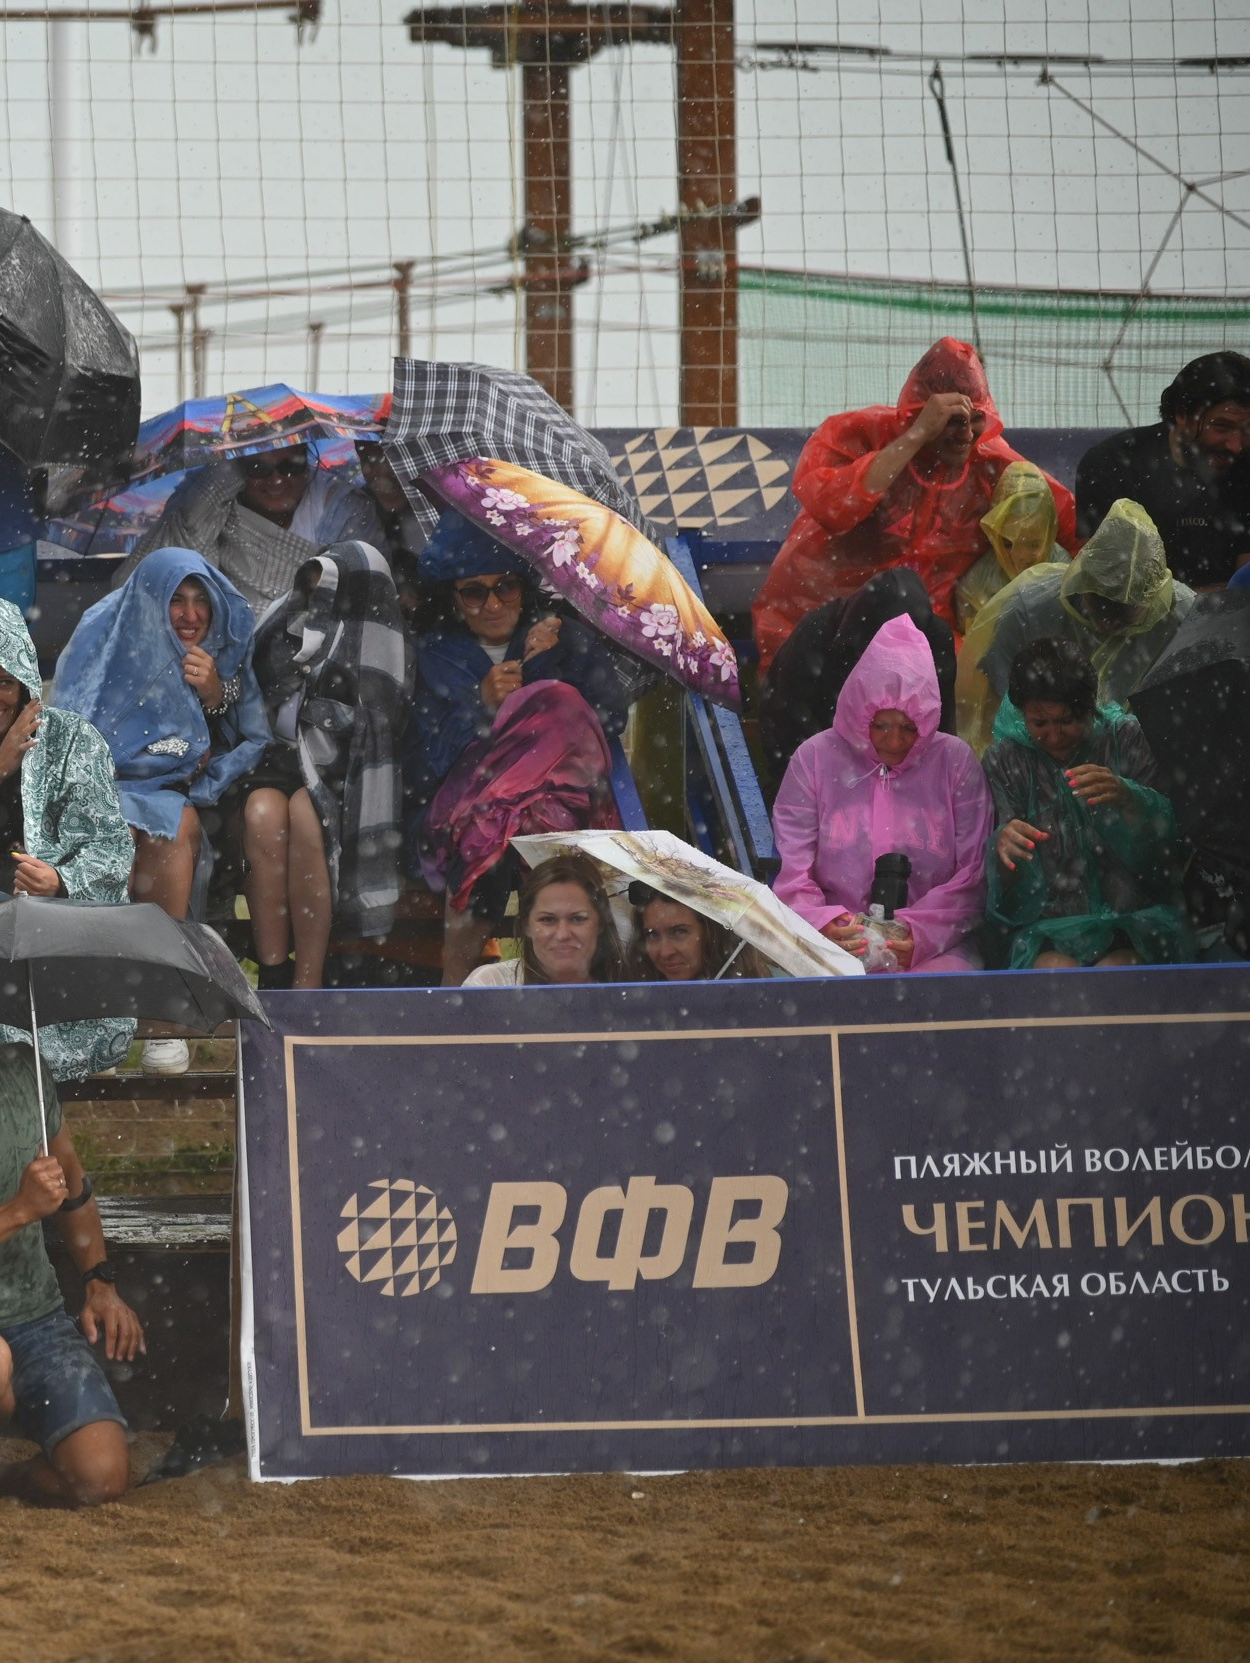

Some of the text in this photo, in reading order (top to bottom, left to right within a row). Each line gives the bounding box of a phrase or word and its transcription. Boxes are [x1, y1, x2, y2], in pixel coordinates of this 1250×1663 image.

[894, 1140, 1250, 1179] ПЛЯЖНЫЙ ВОЛЕЙБО
[471, 1175, 789, 1294] ВФВ
[902, 1269, 1229, 1303] ТУЛЬСКАЯ ОБЛАСТЬ
